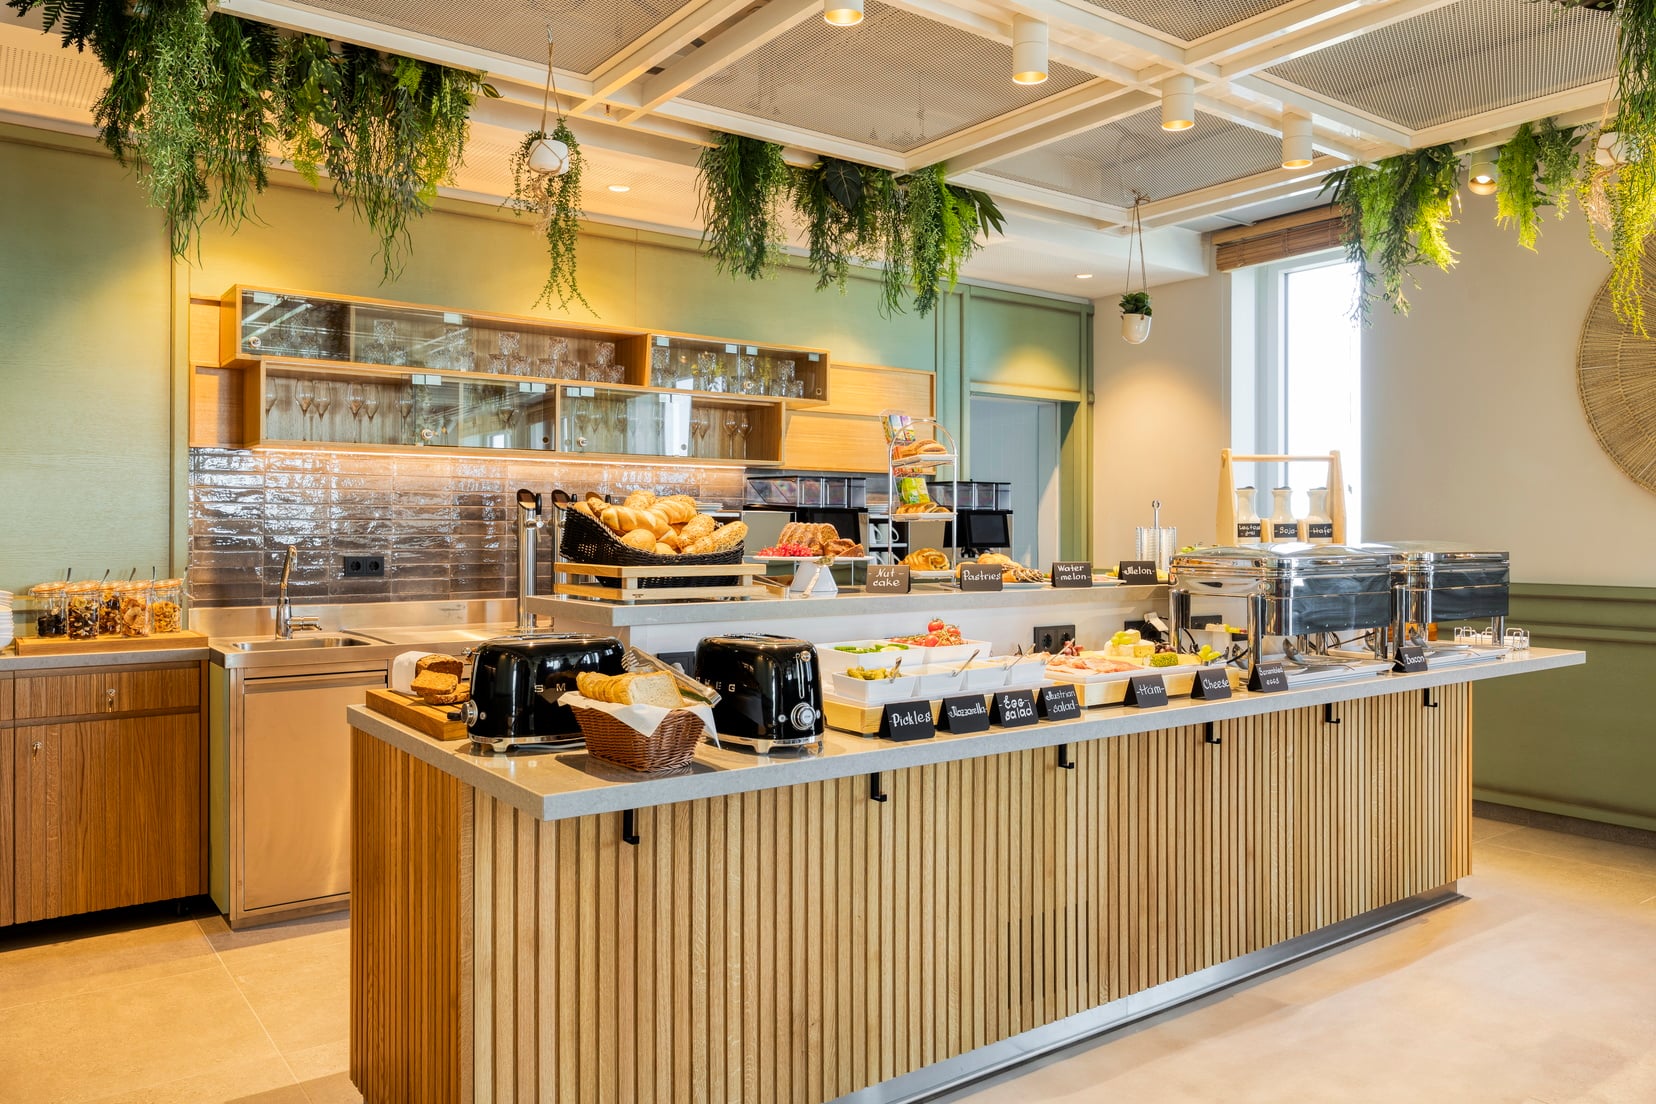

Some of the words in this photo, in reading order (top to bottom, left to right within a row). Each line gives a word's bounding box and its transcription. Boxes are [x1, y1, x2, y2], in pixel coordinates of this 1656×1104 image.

[1280, 526, 1296, 534] Soja
[876, 568, 895, 578] Nut
[962, 569, 1000, 580] Pastries
[1124, 566, 1152, 575] Melon
[872, 578, 900, 587] cake
[1203, 678, 1230, 690] Cheese
[948, 702, 986, 718] Mozzarella
[1005, 702, 1033, 720] salad
[1053, 700, 1075, 713] salad
[891, 710, 931, 727] Pickles
